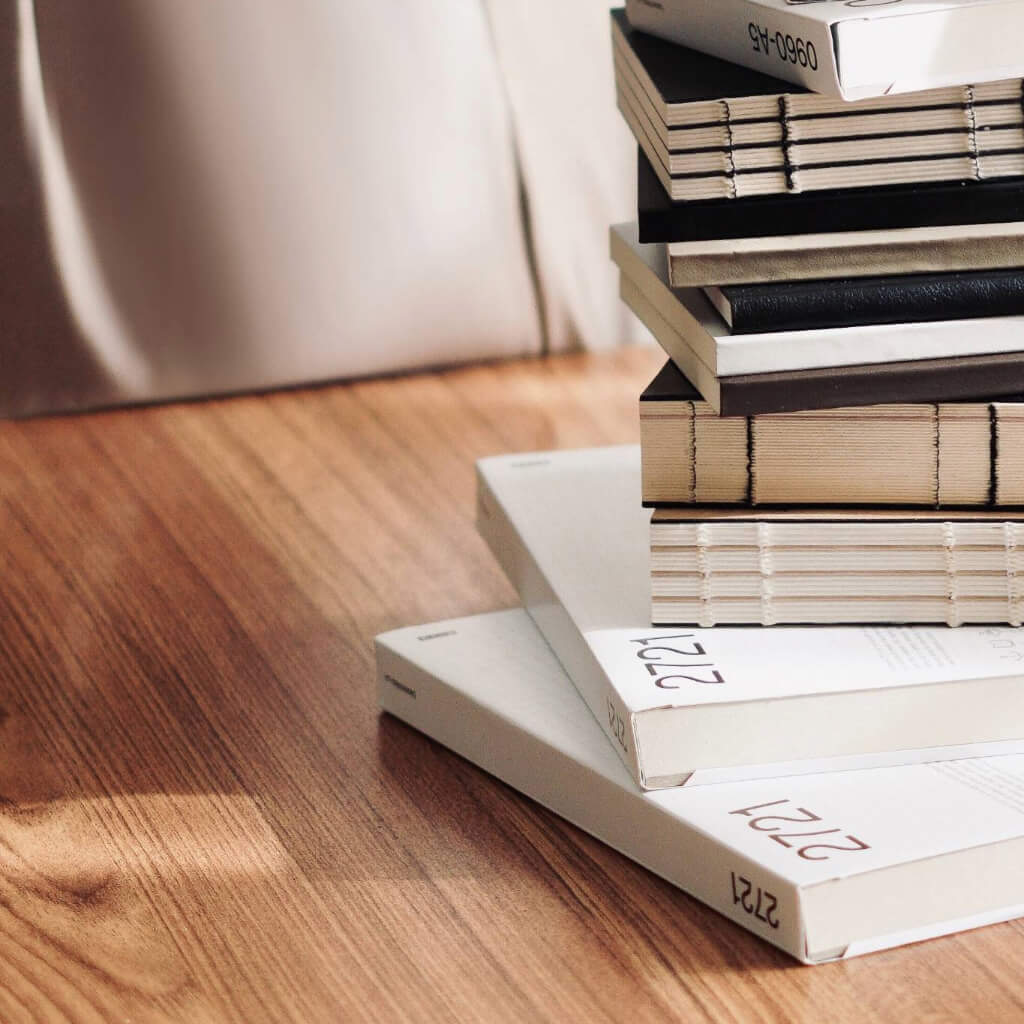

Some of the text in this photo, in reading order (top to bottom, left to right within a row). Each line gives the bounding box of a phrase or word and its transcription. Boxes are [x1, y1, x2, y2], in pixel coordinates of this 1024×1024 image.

[748, 22, 818, 72] 0960-A5
[628, 633, 726, 690] 2721
[729, 799, 872, 862] 2721
[730, 871, 780, 931] 2721
